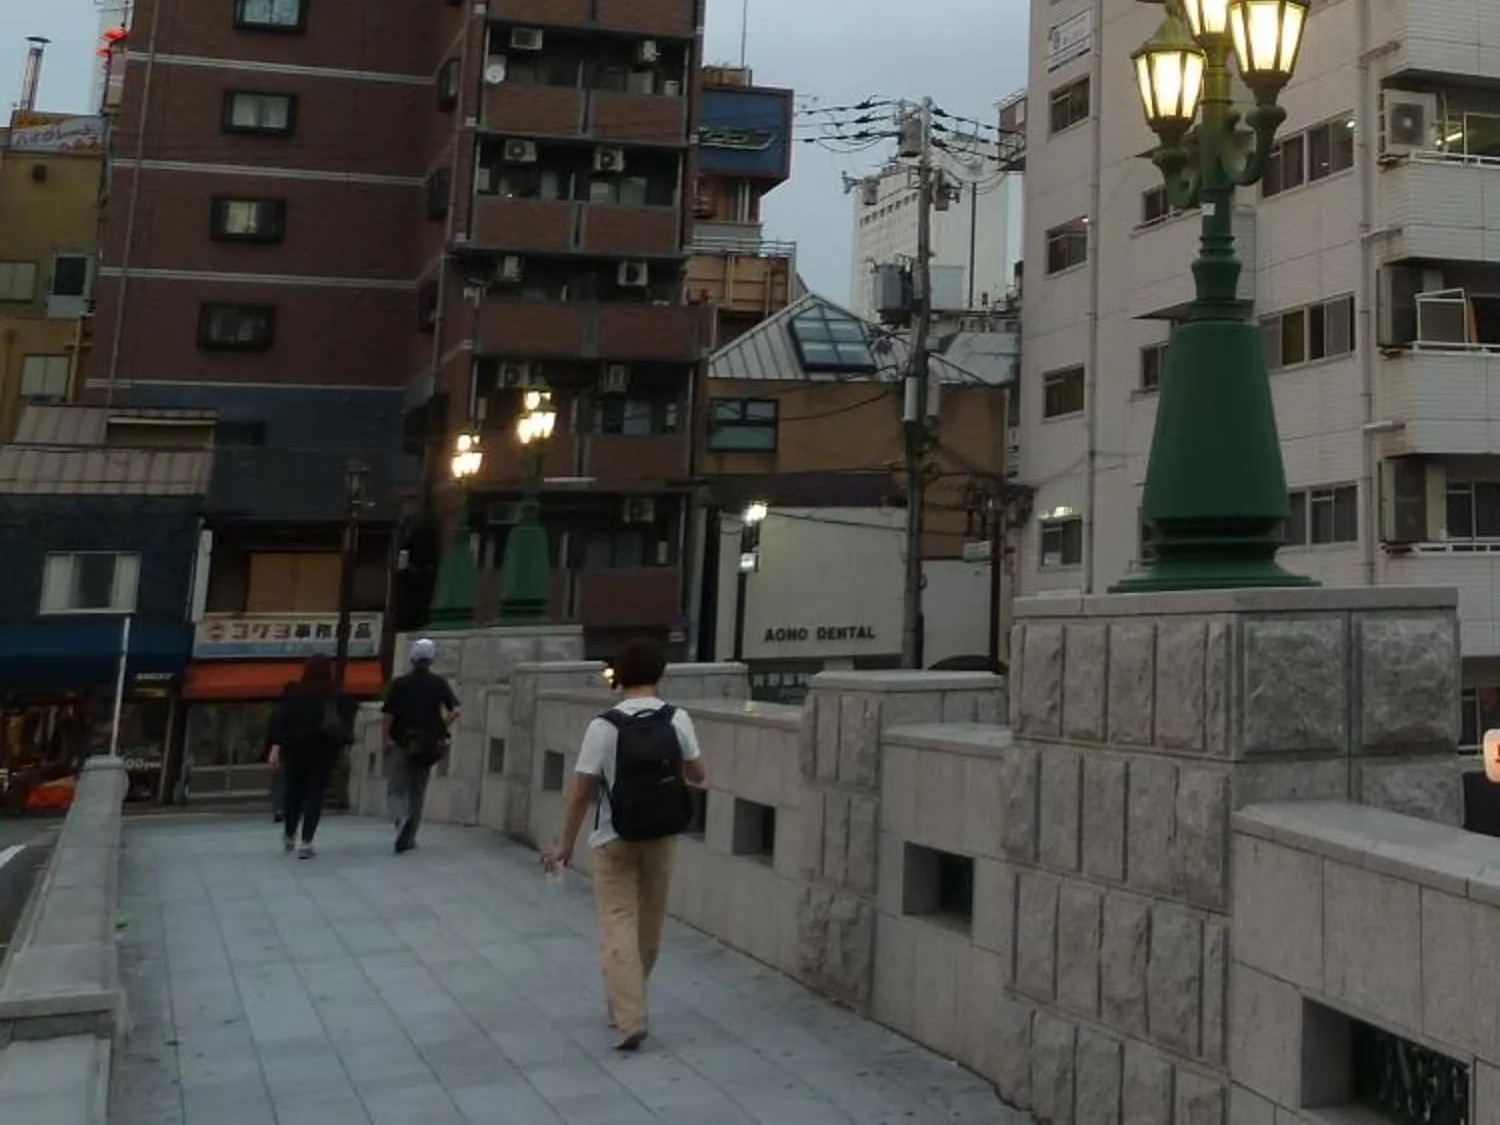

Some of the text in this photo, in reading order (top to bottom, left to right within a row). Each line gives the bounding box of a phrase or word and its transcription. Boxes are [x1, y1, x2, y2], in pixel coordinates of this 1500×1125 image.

[231, 622, 372, 641] コクヨ事務品
[764, 625, 877, 642] AONO DENTAL
